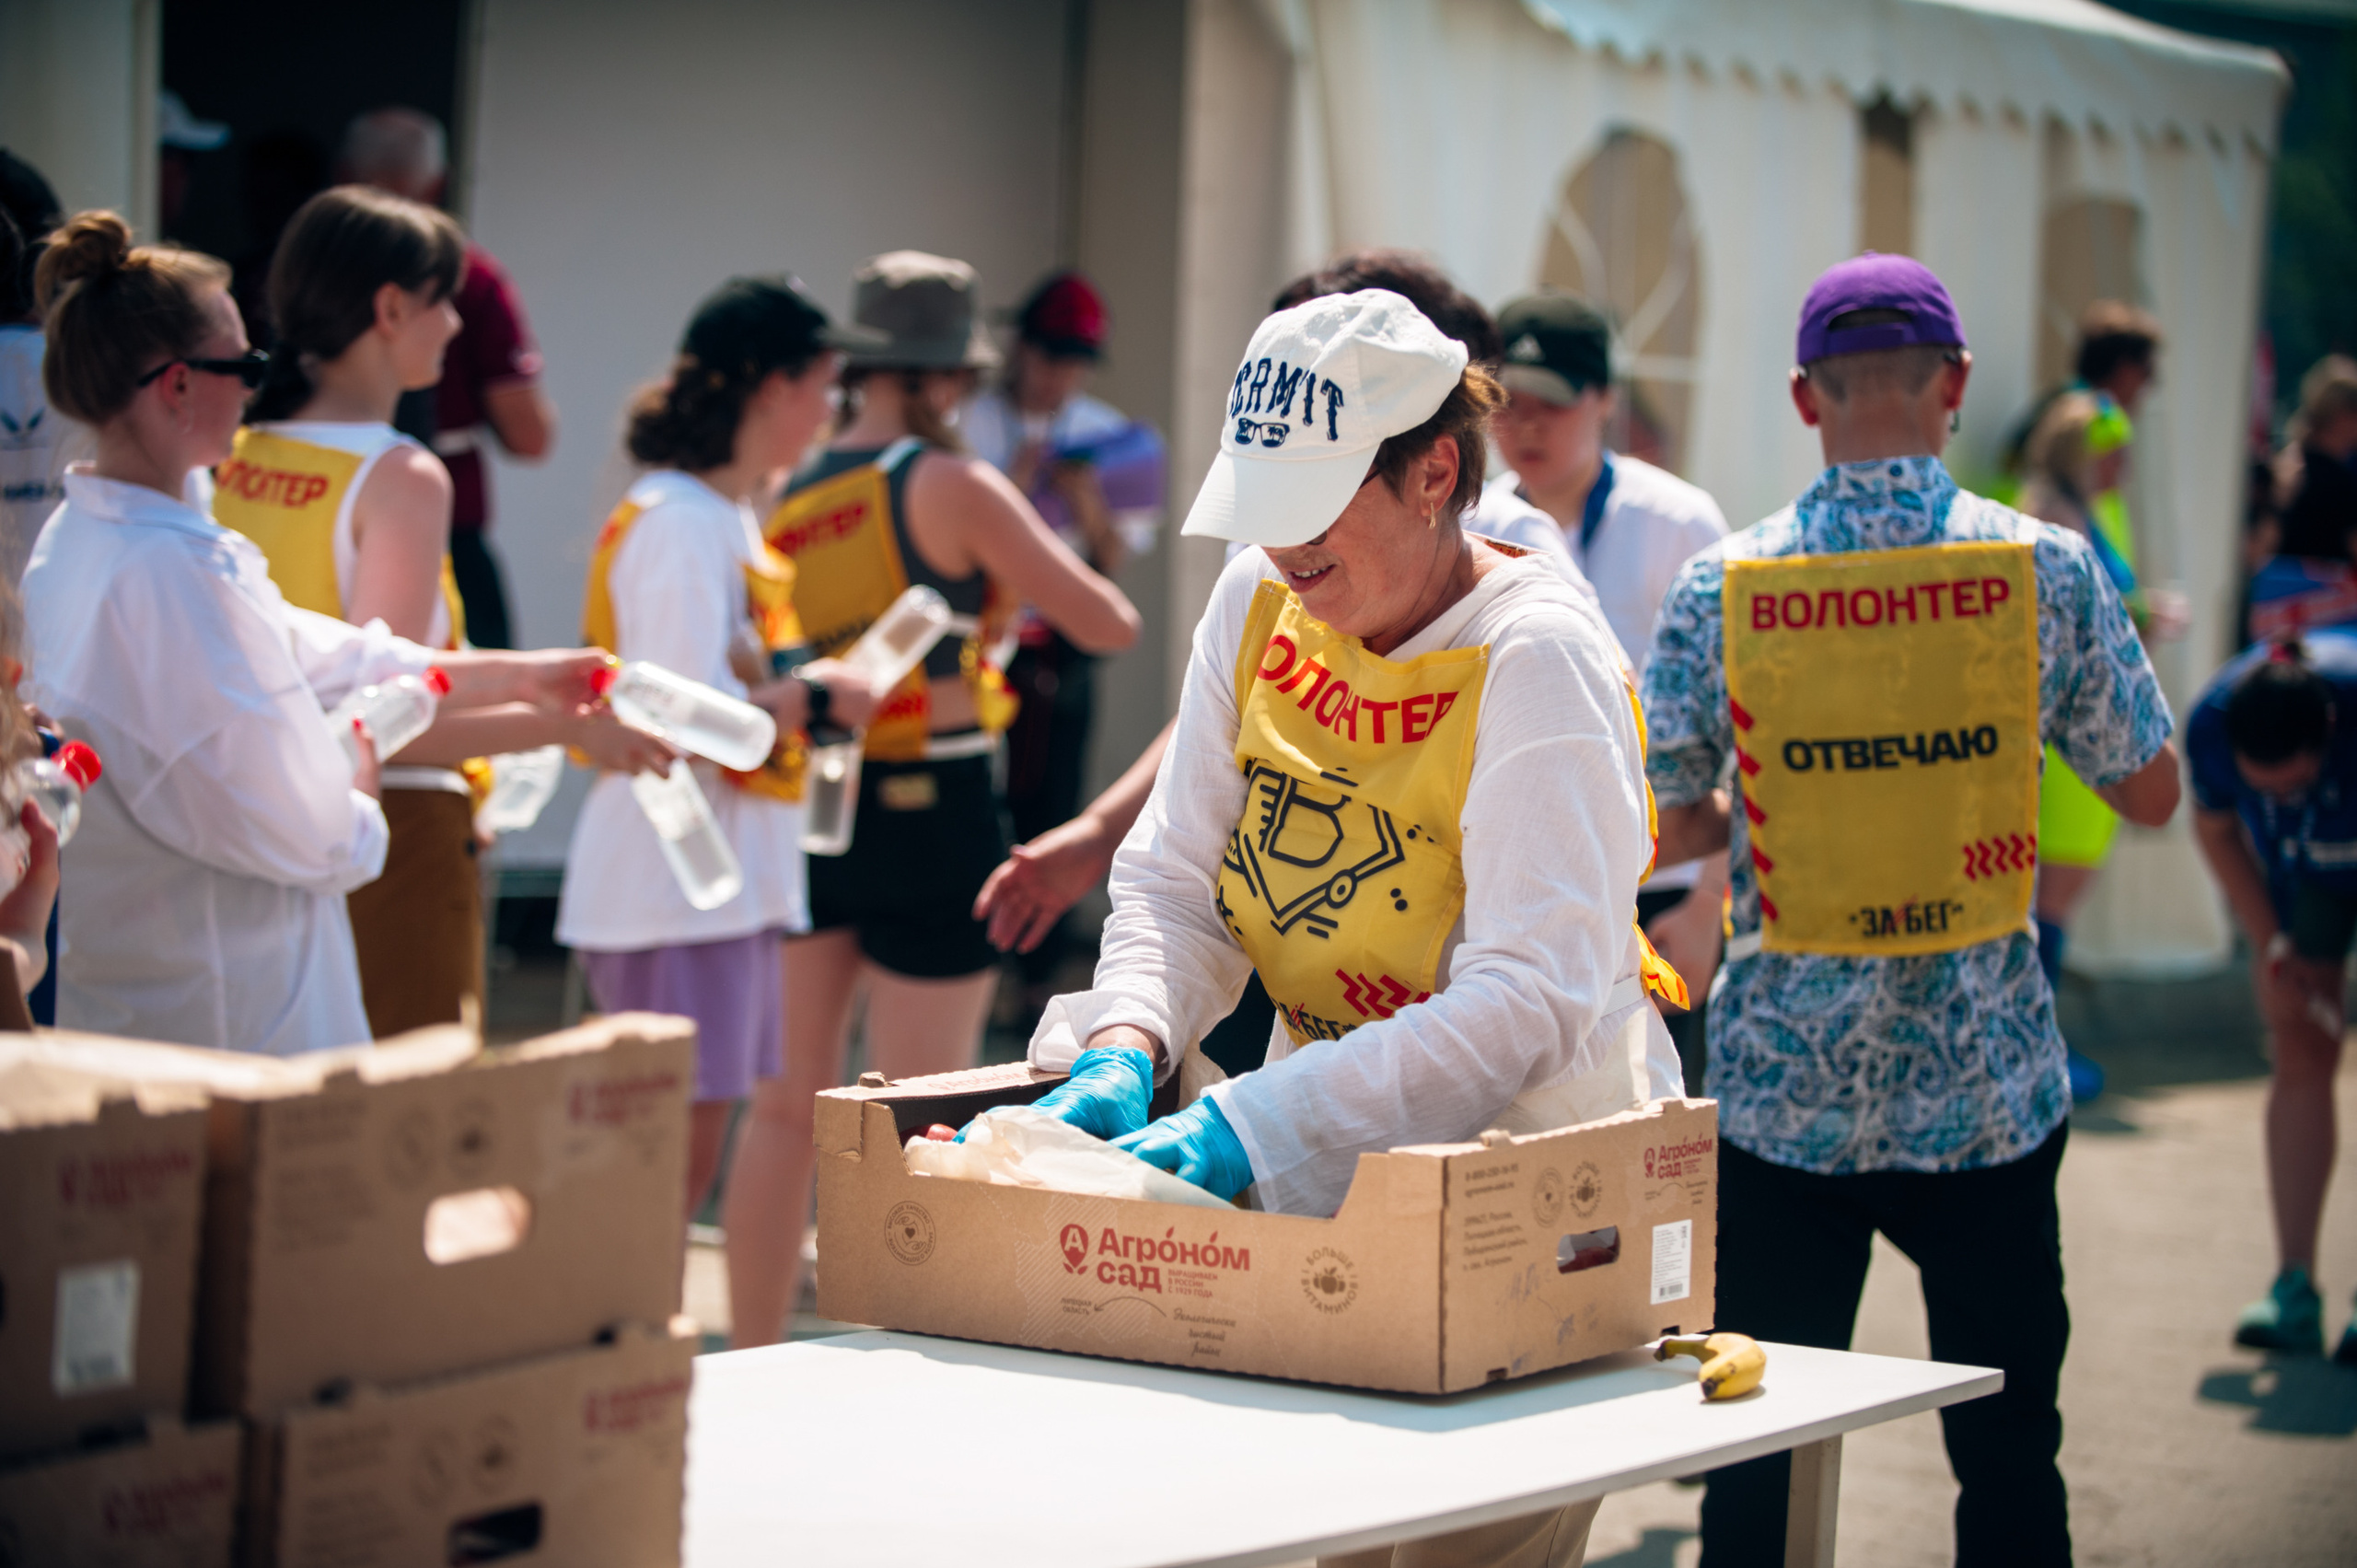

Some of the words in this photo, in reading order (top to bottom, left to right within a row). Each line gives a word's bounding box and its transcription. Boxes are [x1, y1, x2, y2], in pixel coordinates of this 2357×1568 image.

[1751, 577, 2011, 633] ВОЛОНТЕР
[1258, 634, 1459, 744] ОЛОНТЕР
[1782, 725, 1998, 772] ОТВЕЧАЮ
[1097, 1261, 1162, 1294] сад
